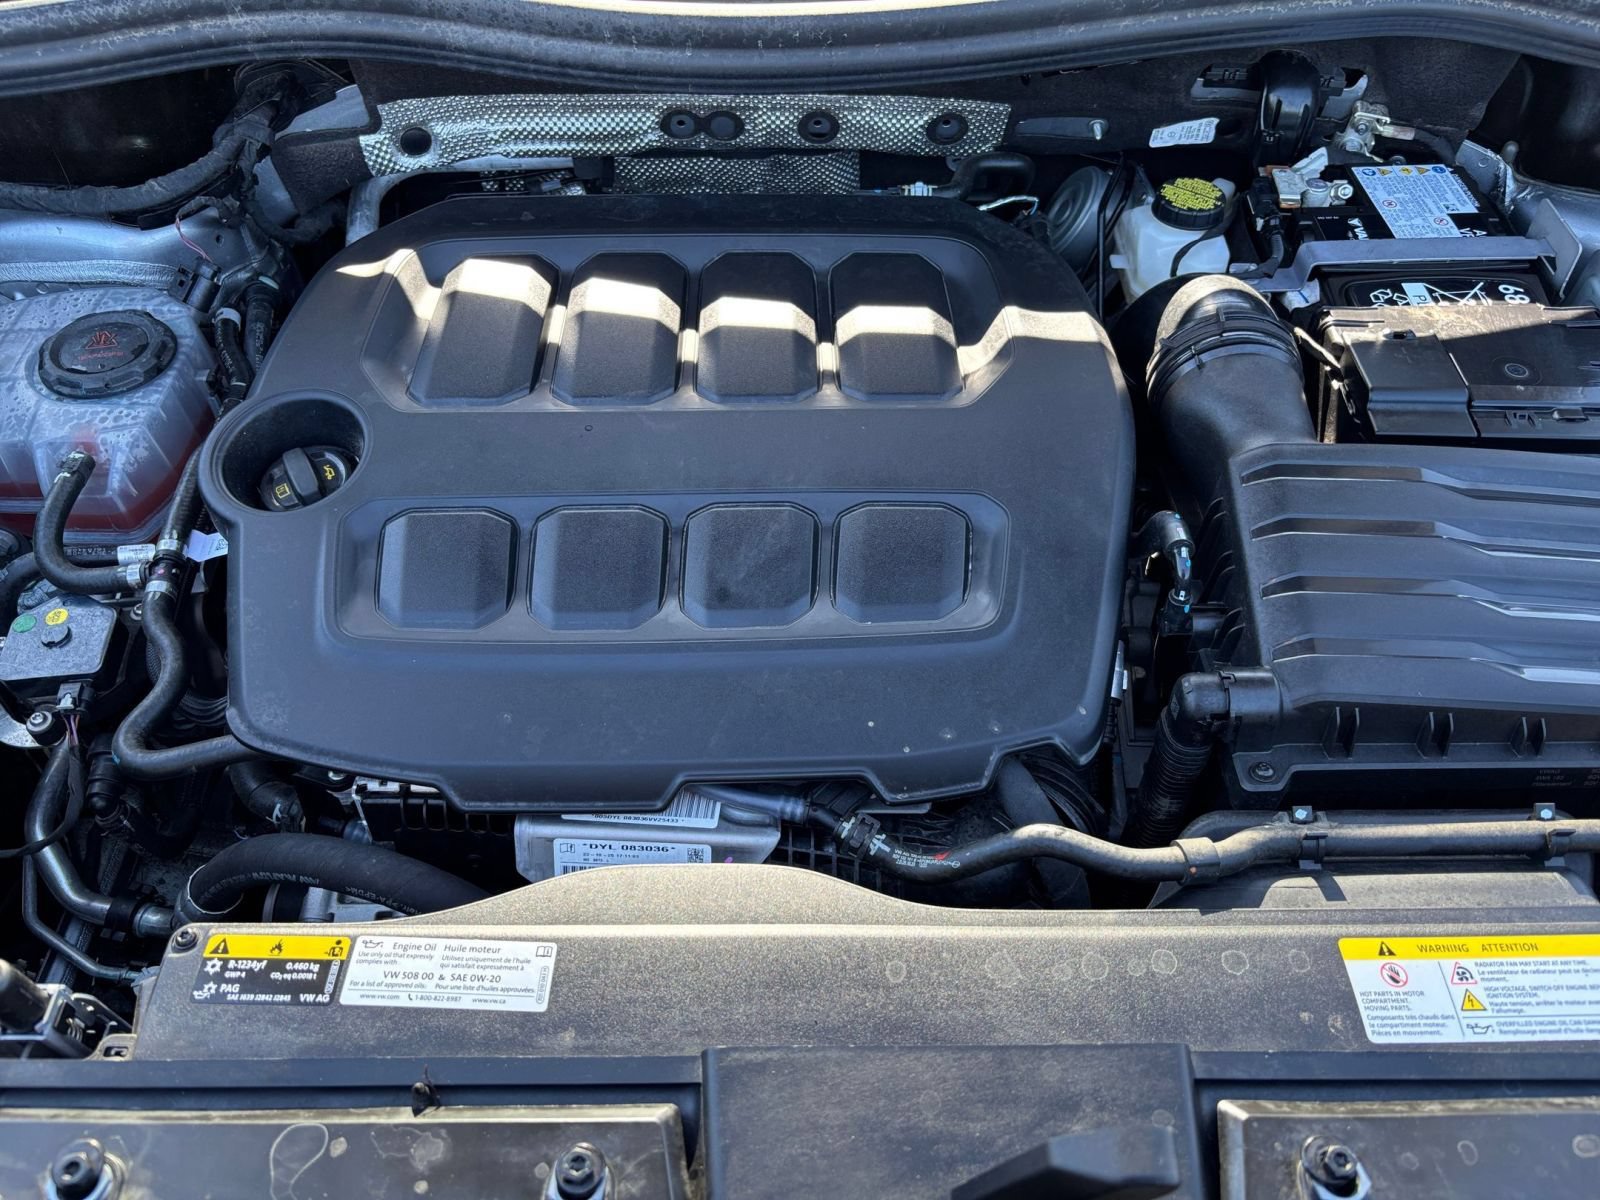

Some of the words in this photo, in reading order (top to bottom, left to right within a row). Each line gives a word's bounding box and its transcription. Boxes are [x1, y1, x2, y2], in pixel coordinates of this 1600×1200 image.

[392, 942, 422, 952] Engine
[424, 943, 437, 952] Oil
[444, 944, 467, 953] Huile
[469, 946, 502, 954] moteur
[1416, 944, 1470, 953] WARNING
[1481, 942, 1539, 952] ATTENTION
[465, 956, 502, 964] uniquement
[228, 960, 268, 972] R-1234yf
[286, 962, 310, 970] 0.460
[310, 962, 320, 972] kg
[224, 970, 240, 978] GWP
[383, 970, 400, 980] VW
[402, 971, 420, 980] 508
[421, 972, 435, 981] 00
[450, 973, 468, 982] SAE
[470, 974, 502, 984] 0W-20
[220, 984, 240, 993] PAG
[300, 994, 316, 1002] VW
[316, 994, 330, 1002] AG
